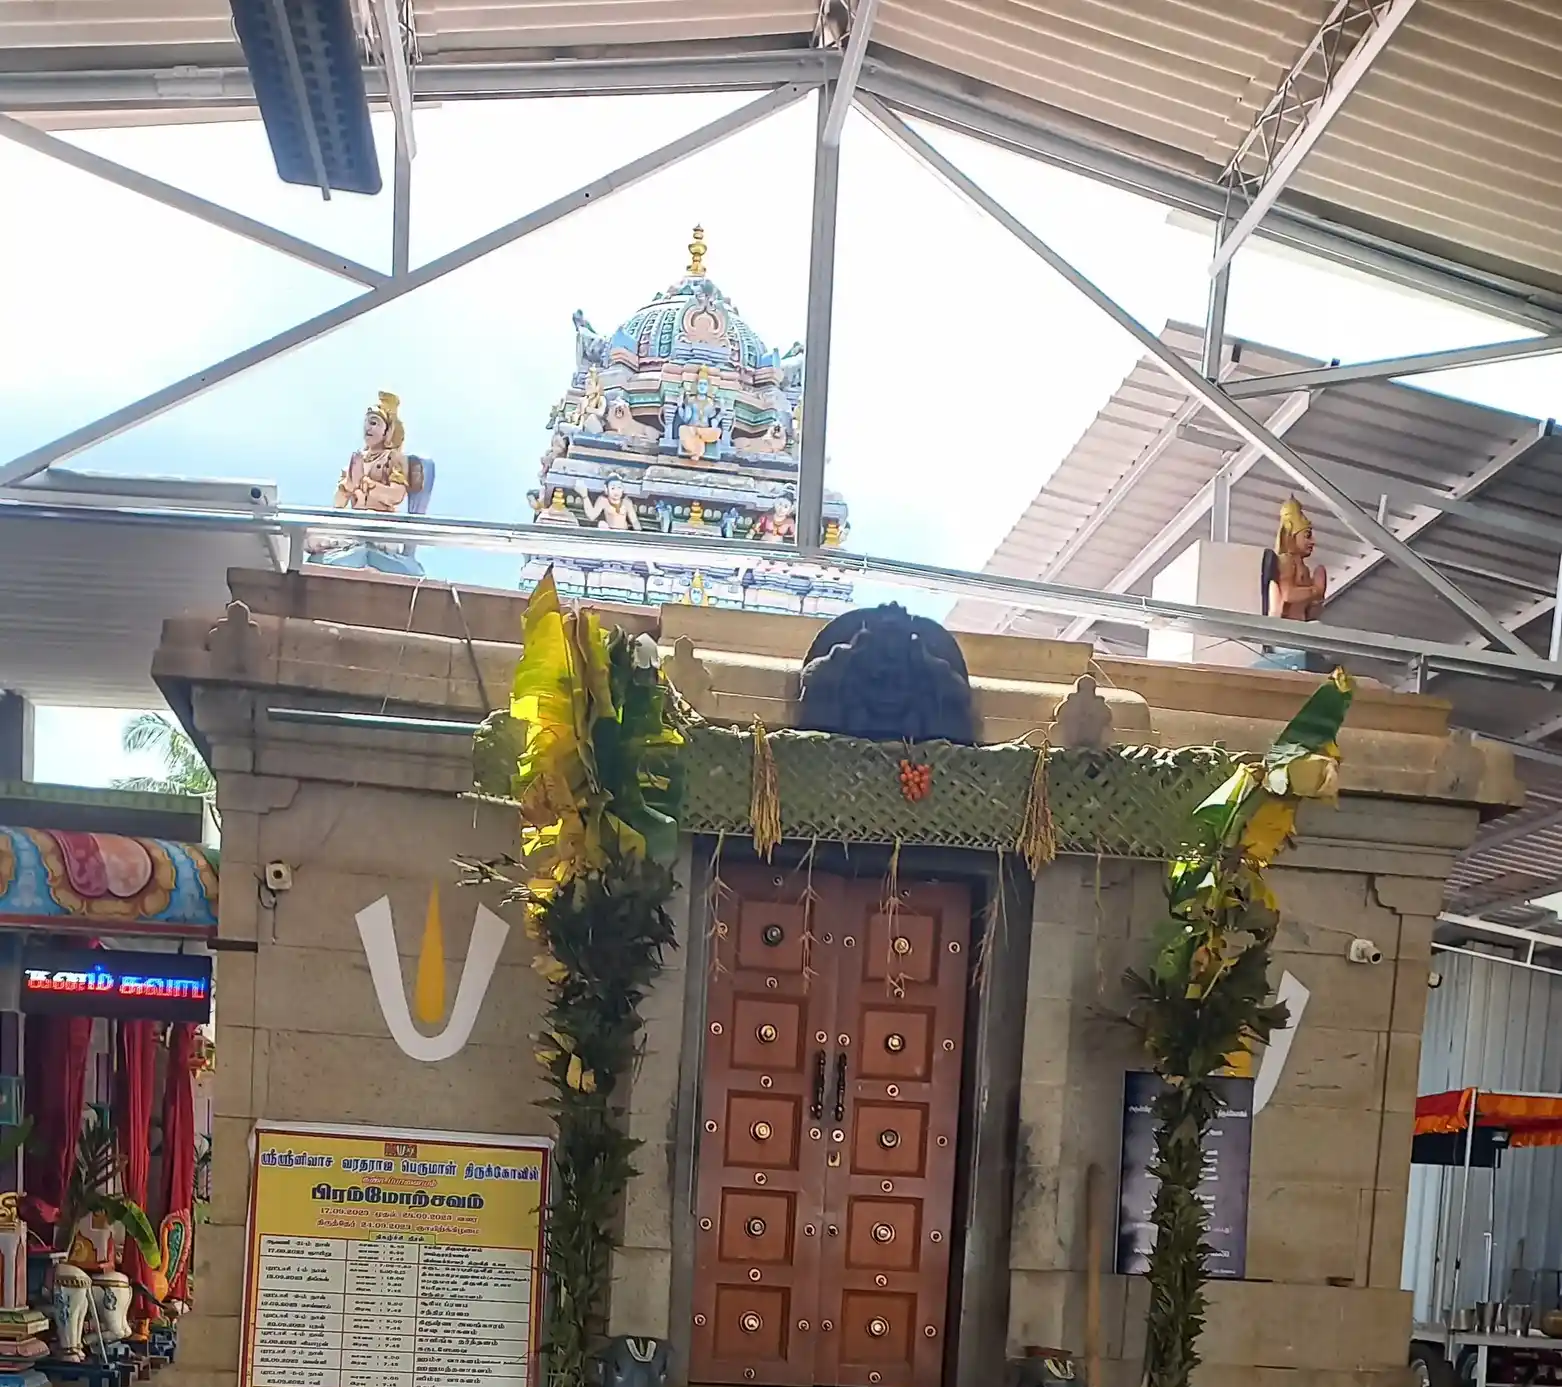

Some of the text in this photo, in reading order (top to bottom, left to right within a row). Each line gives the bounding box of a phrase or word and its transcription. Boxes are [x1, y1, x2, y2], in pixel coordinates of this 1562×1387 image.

[342, 1158, 394, 1172] வரதராஜ
[401, 1160, 456, 1175] பெருமாள்
[465, 1163, 539, 1180] திருக்கோவில்
[312, 1183, 484, 1209] பிரம்மோற்சவம்
